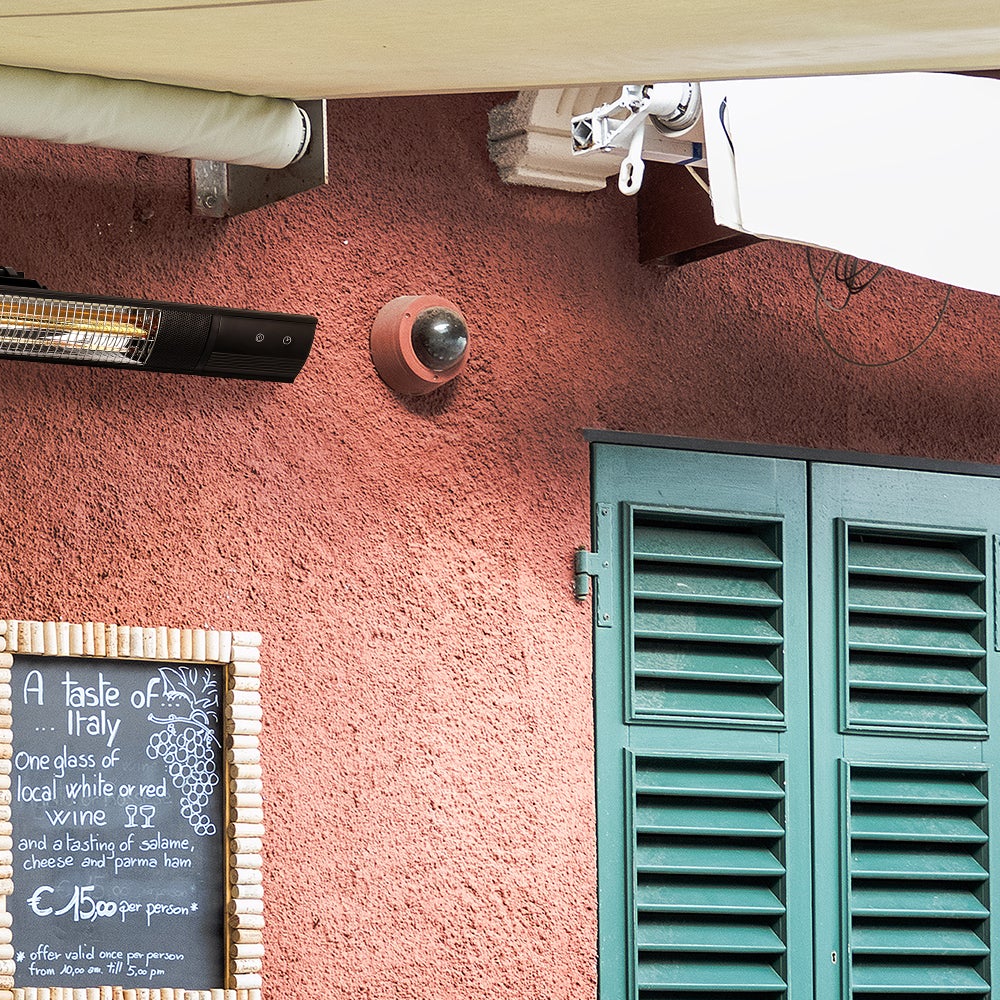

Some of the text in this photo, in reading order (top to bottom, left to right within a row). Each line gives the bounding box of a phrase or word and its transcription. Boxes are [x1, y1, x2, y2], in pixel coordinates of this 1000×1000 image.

[24, 670, 44, 705] A
[62, 671, 120, 708] taste
[67, 710, 121, 747] Italy
[15, 745, 120, 778] One glass of
[17, 775, 56, 802] local
[65, 772, 114, 799] white
[120, 782, 136, 797] or
[139, 777, 166, 797] red
[46, 804, 106, 826] wine
[18, 833, 195, 859] and a tasting of salame,
[24, 853, 191, 873] cheese and parma ham
[120, 901, 143, 923] per
[30, 944, 62, 961] offer
[65, 944, 94, 961] valid
[99, 951, 122, 961] once
[127, 950, 143, 964] per
[147, 951, 184, 964] person
[29, 963, 55, 976] from
[107, 962, 122, 974] till
[149, 967, 165, 980] pm
